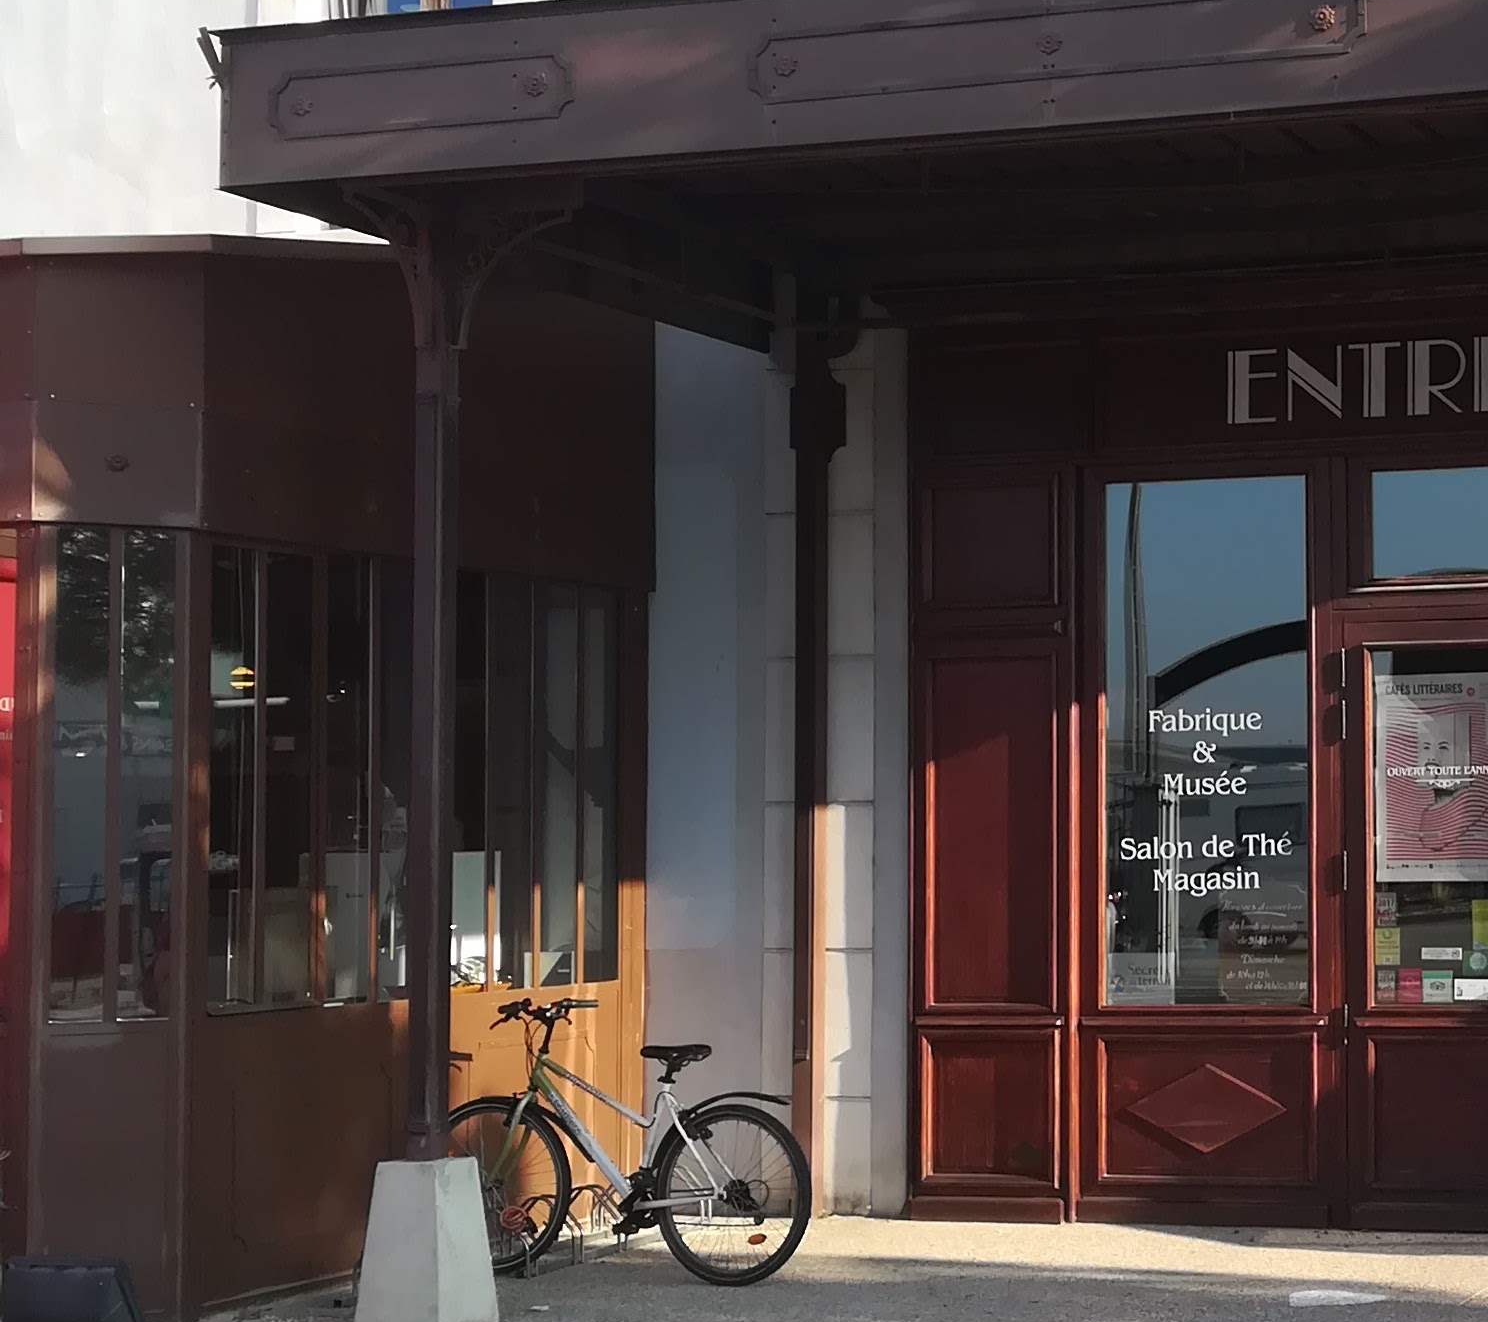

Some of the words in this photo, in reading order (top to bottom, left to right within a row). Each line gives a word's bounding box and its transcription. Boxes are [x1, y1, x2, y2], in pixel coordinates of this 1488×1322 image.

[1148, 707, 1263, 737] Fabrique
[1193, 740, 1217, 764] &
[1163, 770, 1247, 797] Musée
[1387, 765, 1426, 777] OUVERT
[1428, 764, 1463, 776] TOUTE
[1120, 835, 1194, 861] Salon
[1201, 834, 1235, 859] de
[1241, 830, 1293, 858] Thé
[1152, 865, 1261, 897] Magasin
